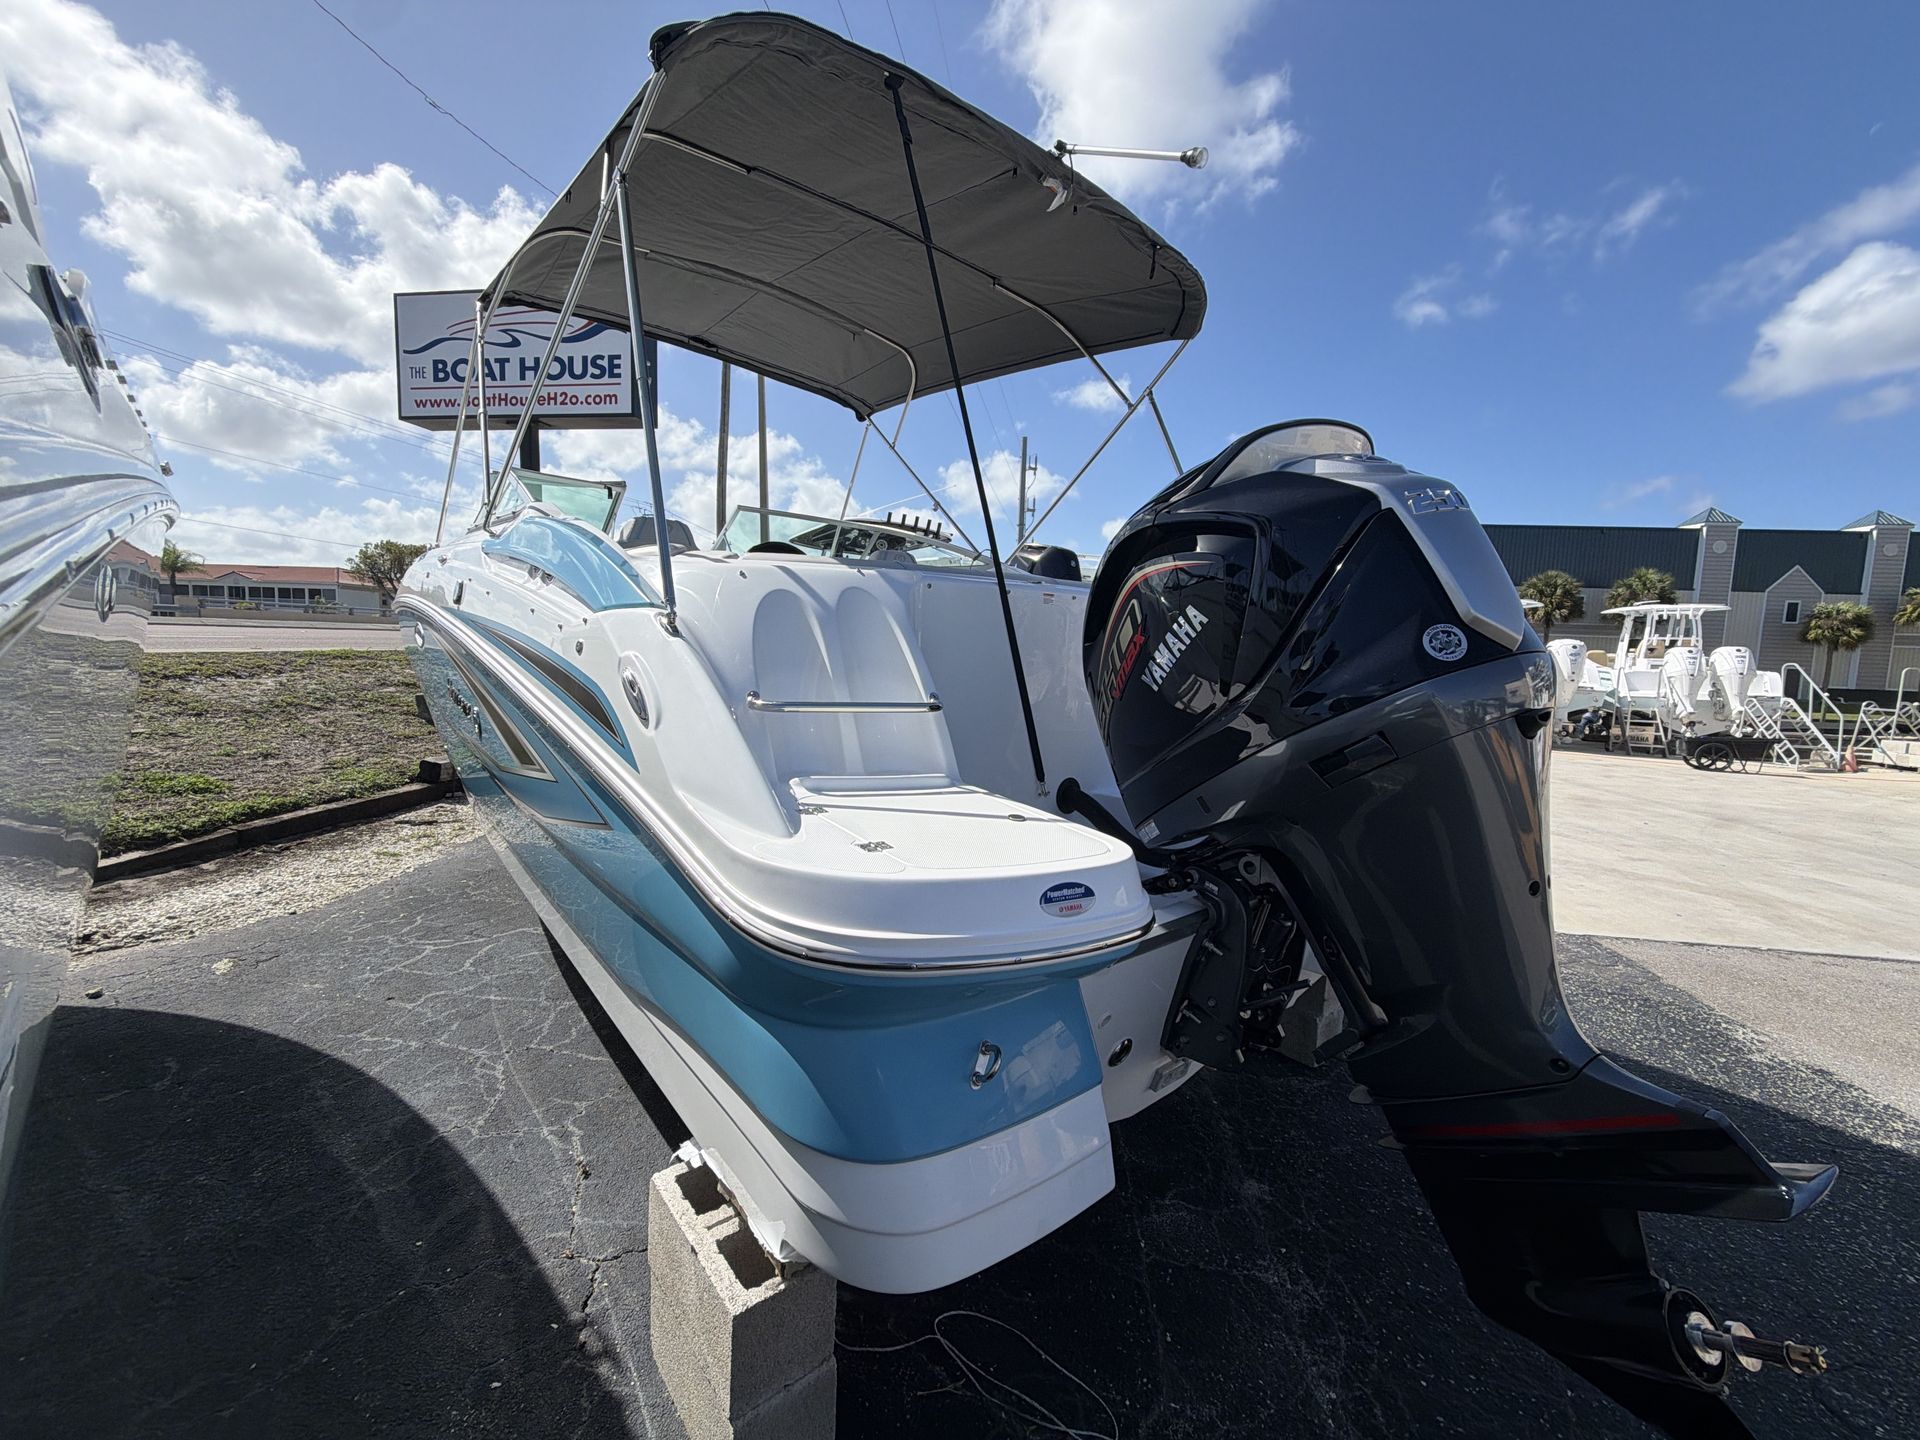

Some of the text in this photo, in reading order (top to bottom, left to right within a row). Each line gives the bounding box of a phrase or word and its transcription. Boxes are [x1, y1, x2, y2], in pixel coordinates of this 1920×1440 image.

[409, 354, 622, 383] THE BOAT HOUSE
[414, 391, 618, 408] www.oatHoueH2o.com
[1404, 488, 1470, 515] 250
[1141, 604, 1210, 692] YAMAHA
[1046, 886, 1085, 899] PowerMatched
[1064, 903, 1083, 912] YAMAHA
